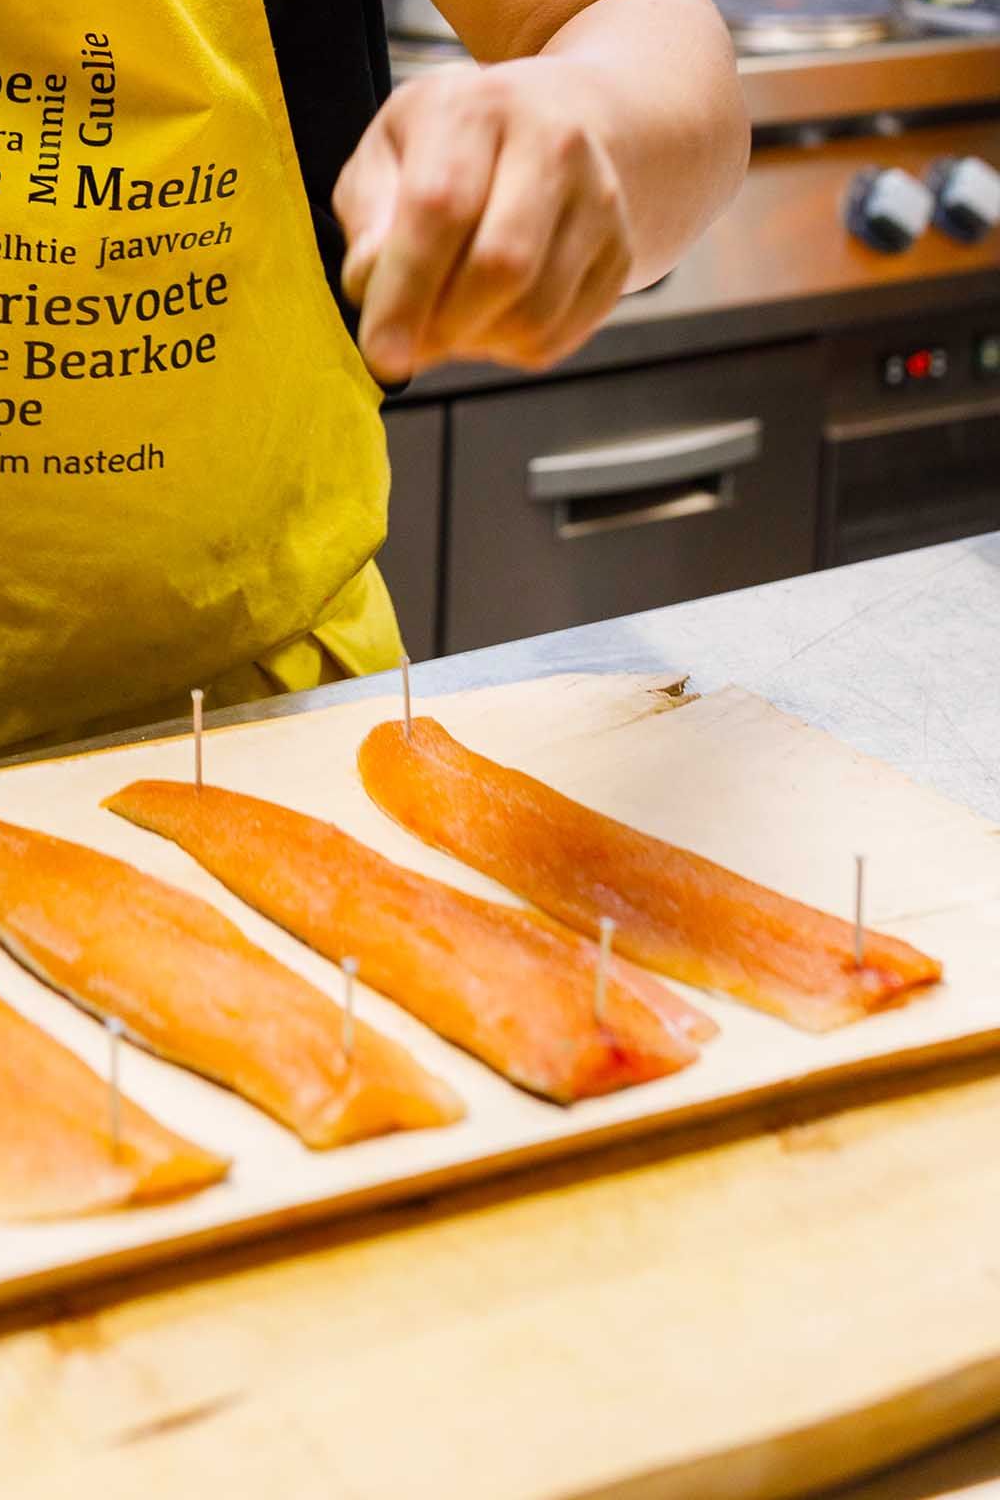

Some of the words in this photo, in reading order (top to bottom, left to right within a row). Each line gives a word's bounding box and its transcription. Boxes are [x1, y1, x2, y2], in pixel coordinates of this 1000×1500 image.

[79, 32, 116, 147] Guelie
[29, 73, 67, 205] Munnie
[73, 164, 238, 211] Maelie
[23, 332, 216, 380] Bearkoe
[43, 443, 165, 475] nastedh
